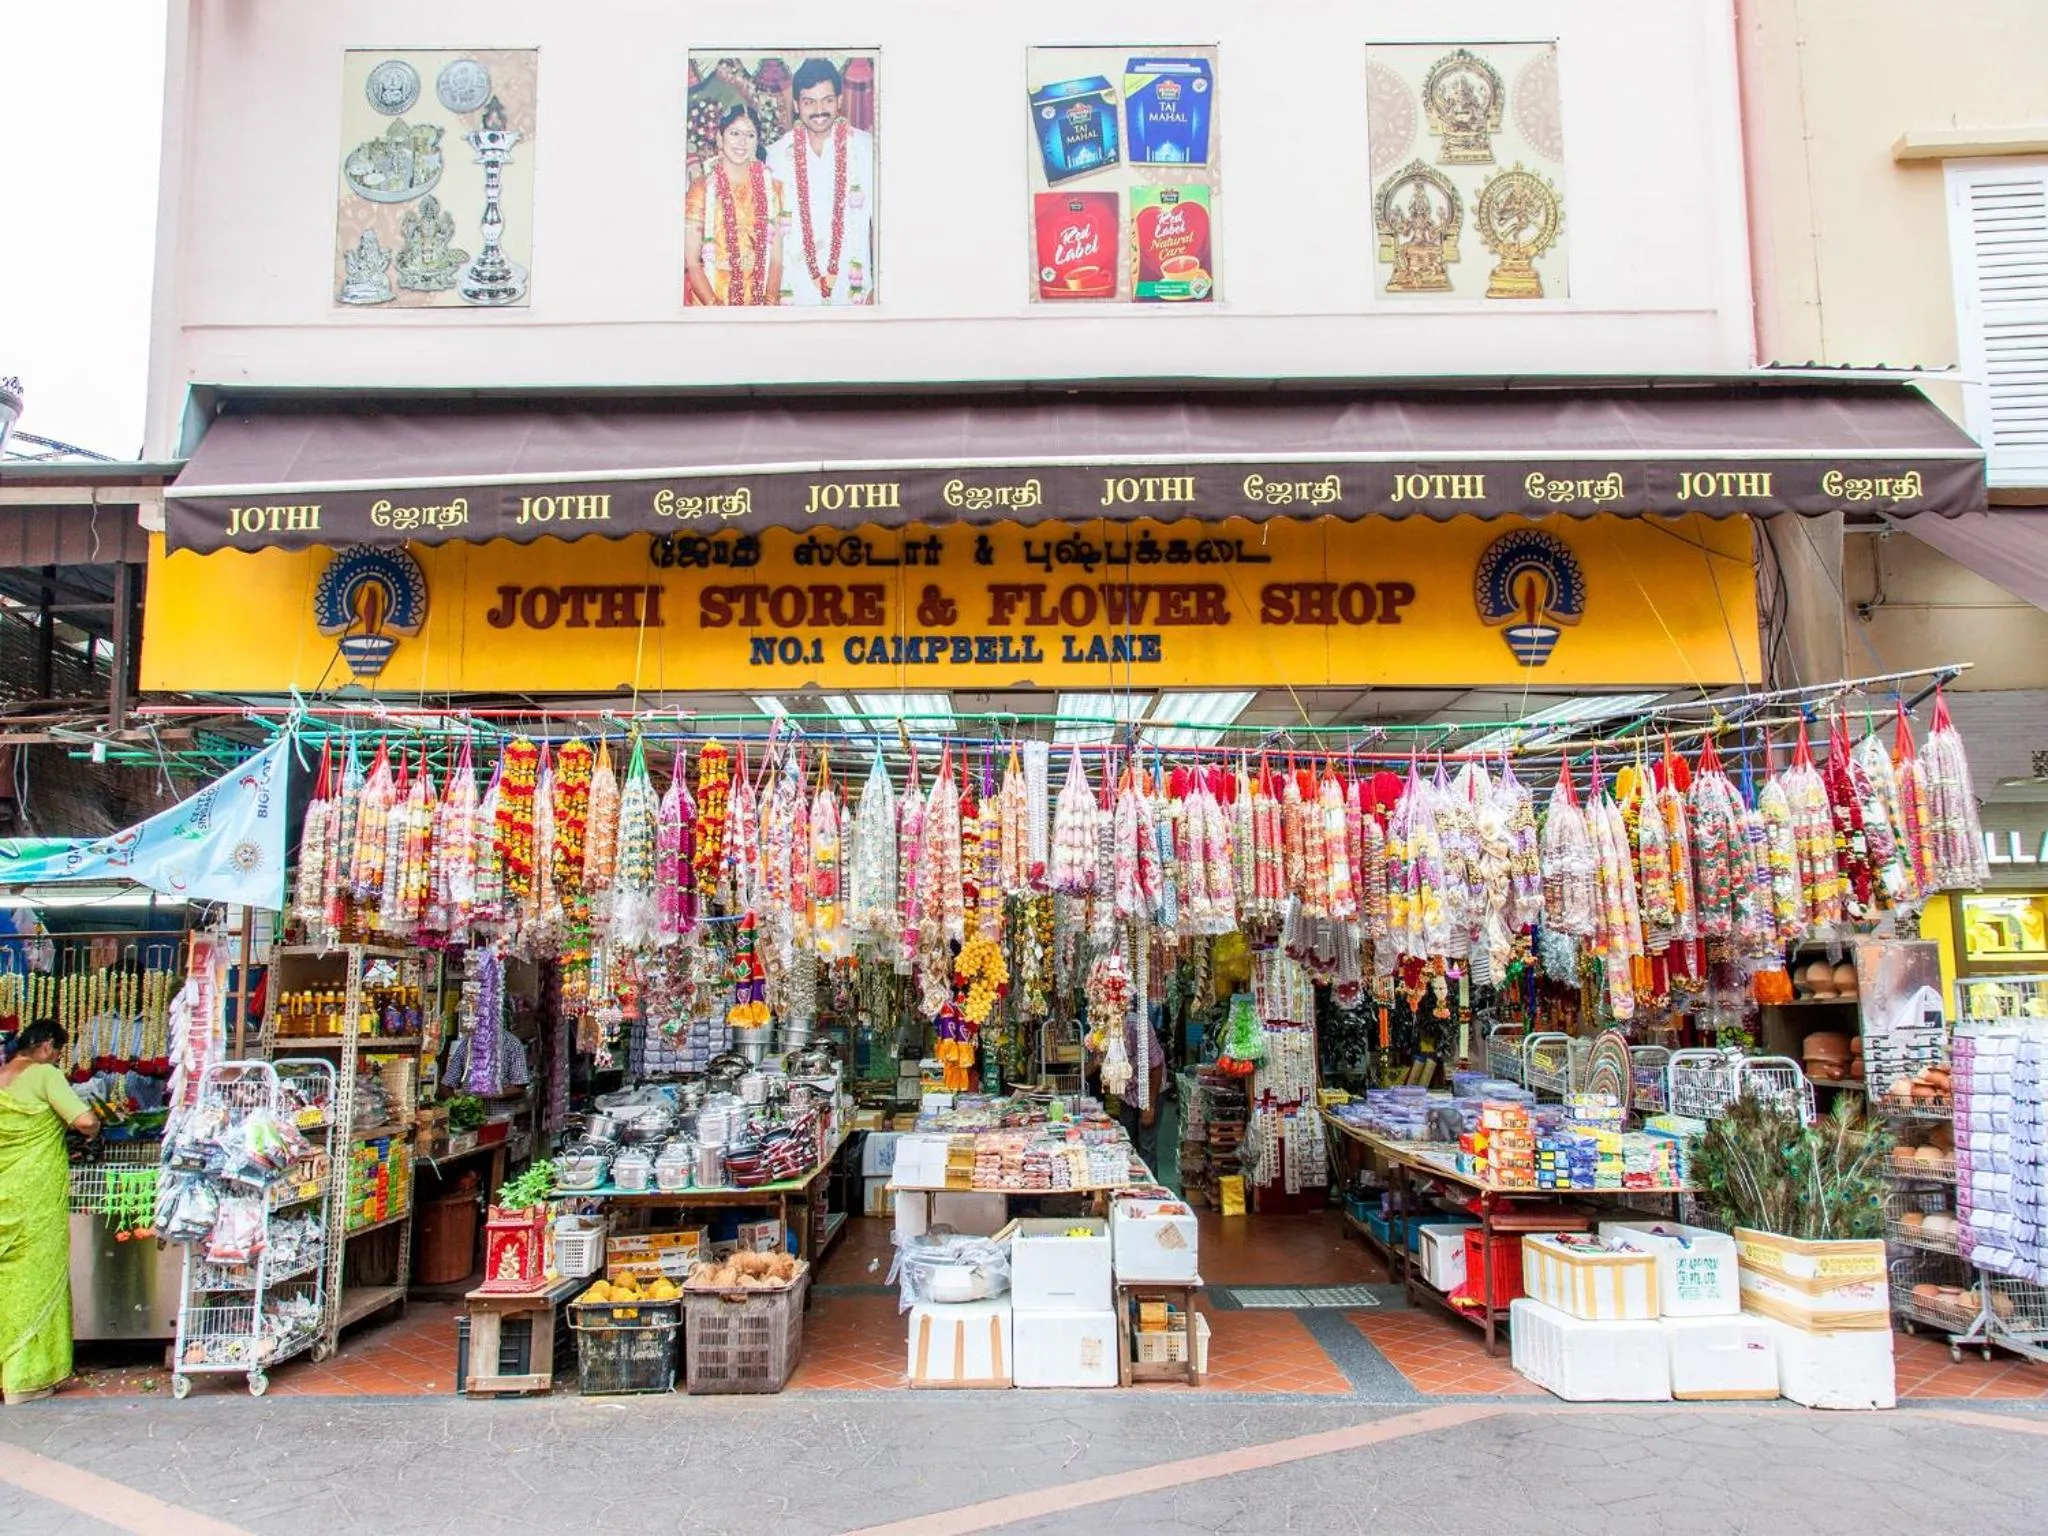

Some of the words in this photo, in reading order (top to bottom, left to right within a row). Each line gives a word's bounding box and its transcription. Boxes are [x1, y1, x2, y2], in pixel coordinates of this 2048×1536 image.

[1149, 112, 1188, 122] MAHAL
[1066, 130, 1098, 144] MAHAL
[1155, 221, 1186, 238] Label
[1157, 211, 1183, 225] Red
[1060, 223, 1091, 246] Red
[1149, 232, 1195, 252] Natural
[1054, 235, 1099, 265] Label
[805, 483, 901, 513] JOTHI
[943, 478, 1042, 511] ஜோதி
[1101, 476, 1195, 506] JOTHI
[1243, 473, 1342, 506] ஜோதி
[1391, 474, 1486, 502] JOTHI
[1525, 471, 1625, 503] ஜோதி
[1677, 471, 1772, 500] JOTHI
[1822, 470, 1923, 502] ஜோதி
[371, 499, 468, 530] ஜோதி
[516, 494, 611, 524] JOTHI
[653, 487, 752, 520] ஜோதி
[227, 506, 321, 536] JOTHI
[973, 535, 995, 566] &
[487, 583, 667, 629] JOTHI
[699, 583, 886, 628] STORE
[917, 584, 958, 627] &
[986, 583, 1231, 627] FLOWER
[1260, 582, 1416, 625] SHOP
[750, 637, 824, 665] NO.1
[844, 636, 1043, 665] CAMPBELL
[1062, 635, 1162, 663] LANE
[1984, 831, 2048, 863] LL
